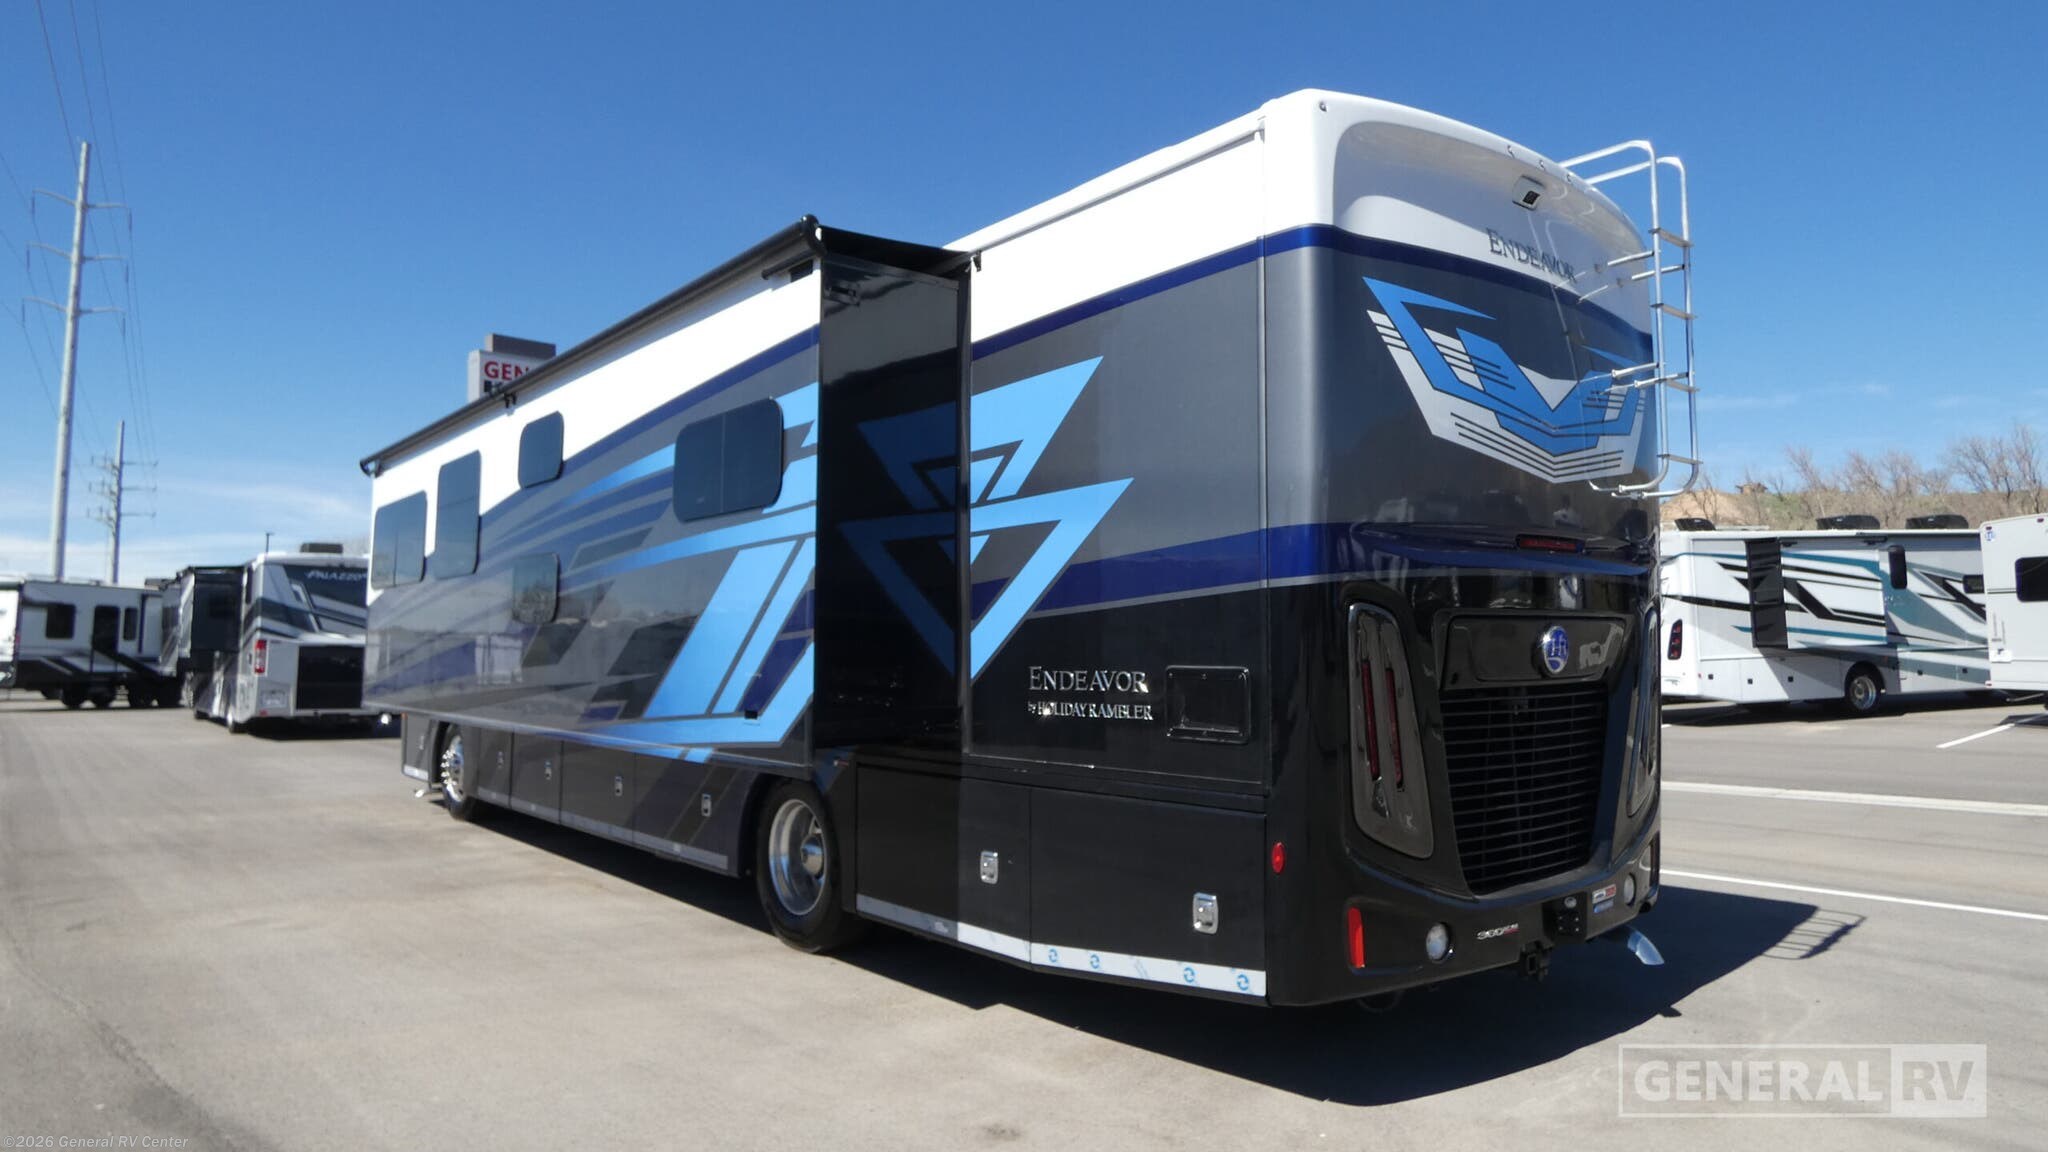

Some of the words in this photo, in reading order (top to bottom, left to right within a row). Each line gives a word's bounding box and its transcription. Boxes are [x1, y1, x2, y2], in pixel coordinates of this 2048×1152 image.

[1487, 228, 1576, 283] ENDEAVOR
[1028, 665, 1149, 694] ENDEAVOR
[1037, 701, 1087, 718] HOLIDAY
[1088, 703, 1154, 721] RAMBLER
